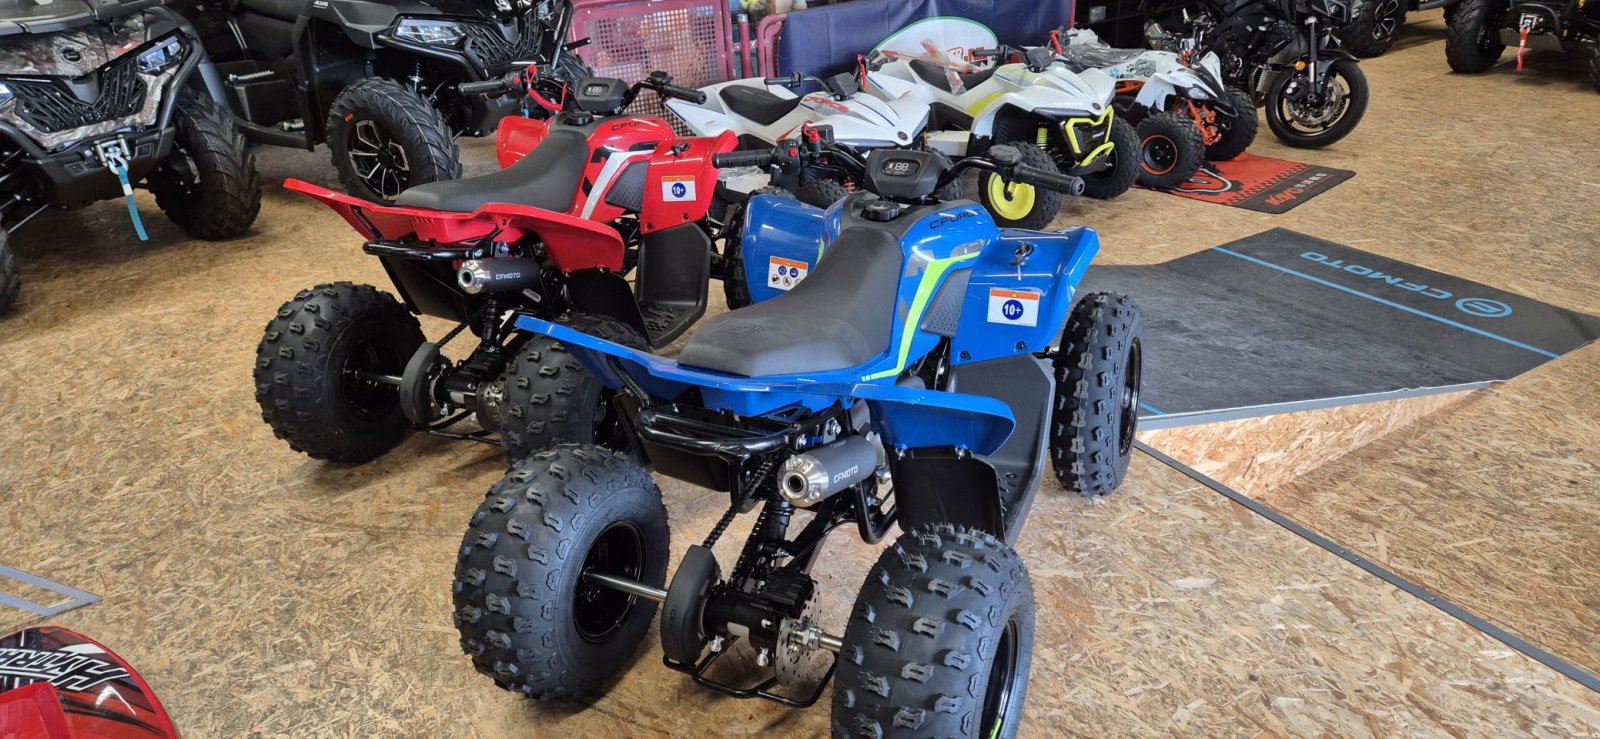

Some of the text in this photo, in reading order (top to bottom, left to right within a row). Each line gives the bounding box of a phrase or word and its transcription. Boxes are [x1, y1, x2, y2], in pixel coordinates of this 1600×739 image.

[672, 185, 685, 195] 10+
[495, 272, 521, 280] CFMOTO
[1300, 251, 1454, 300] CFMOTO
[1003, 304, 1022, 316] 10+
[833, 465, 859, 484] CFMOTO
